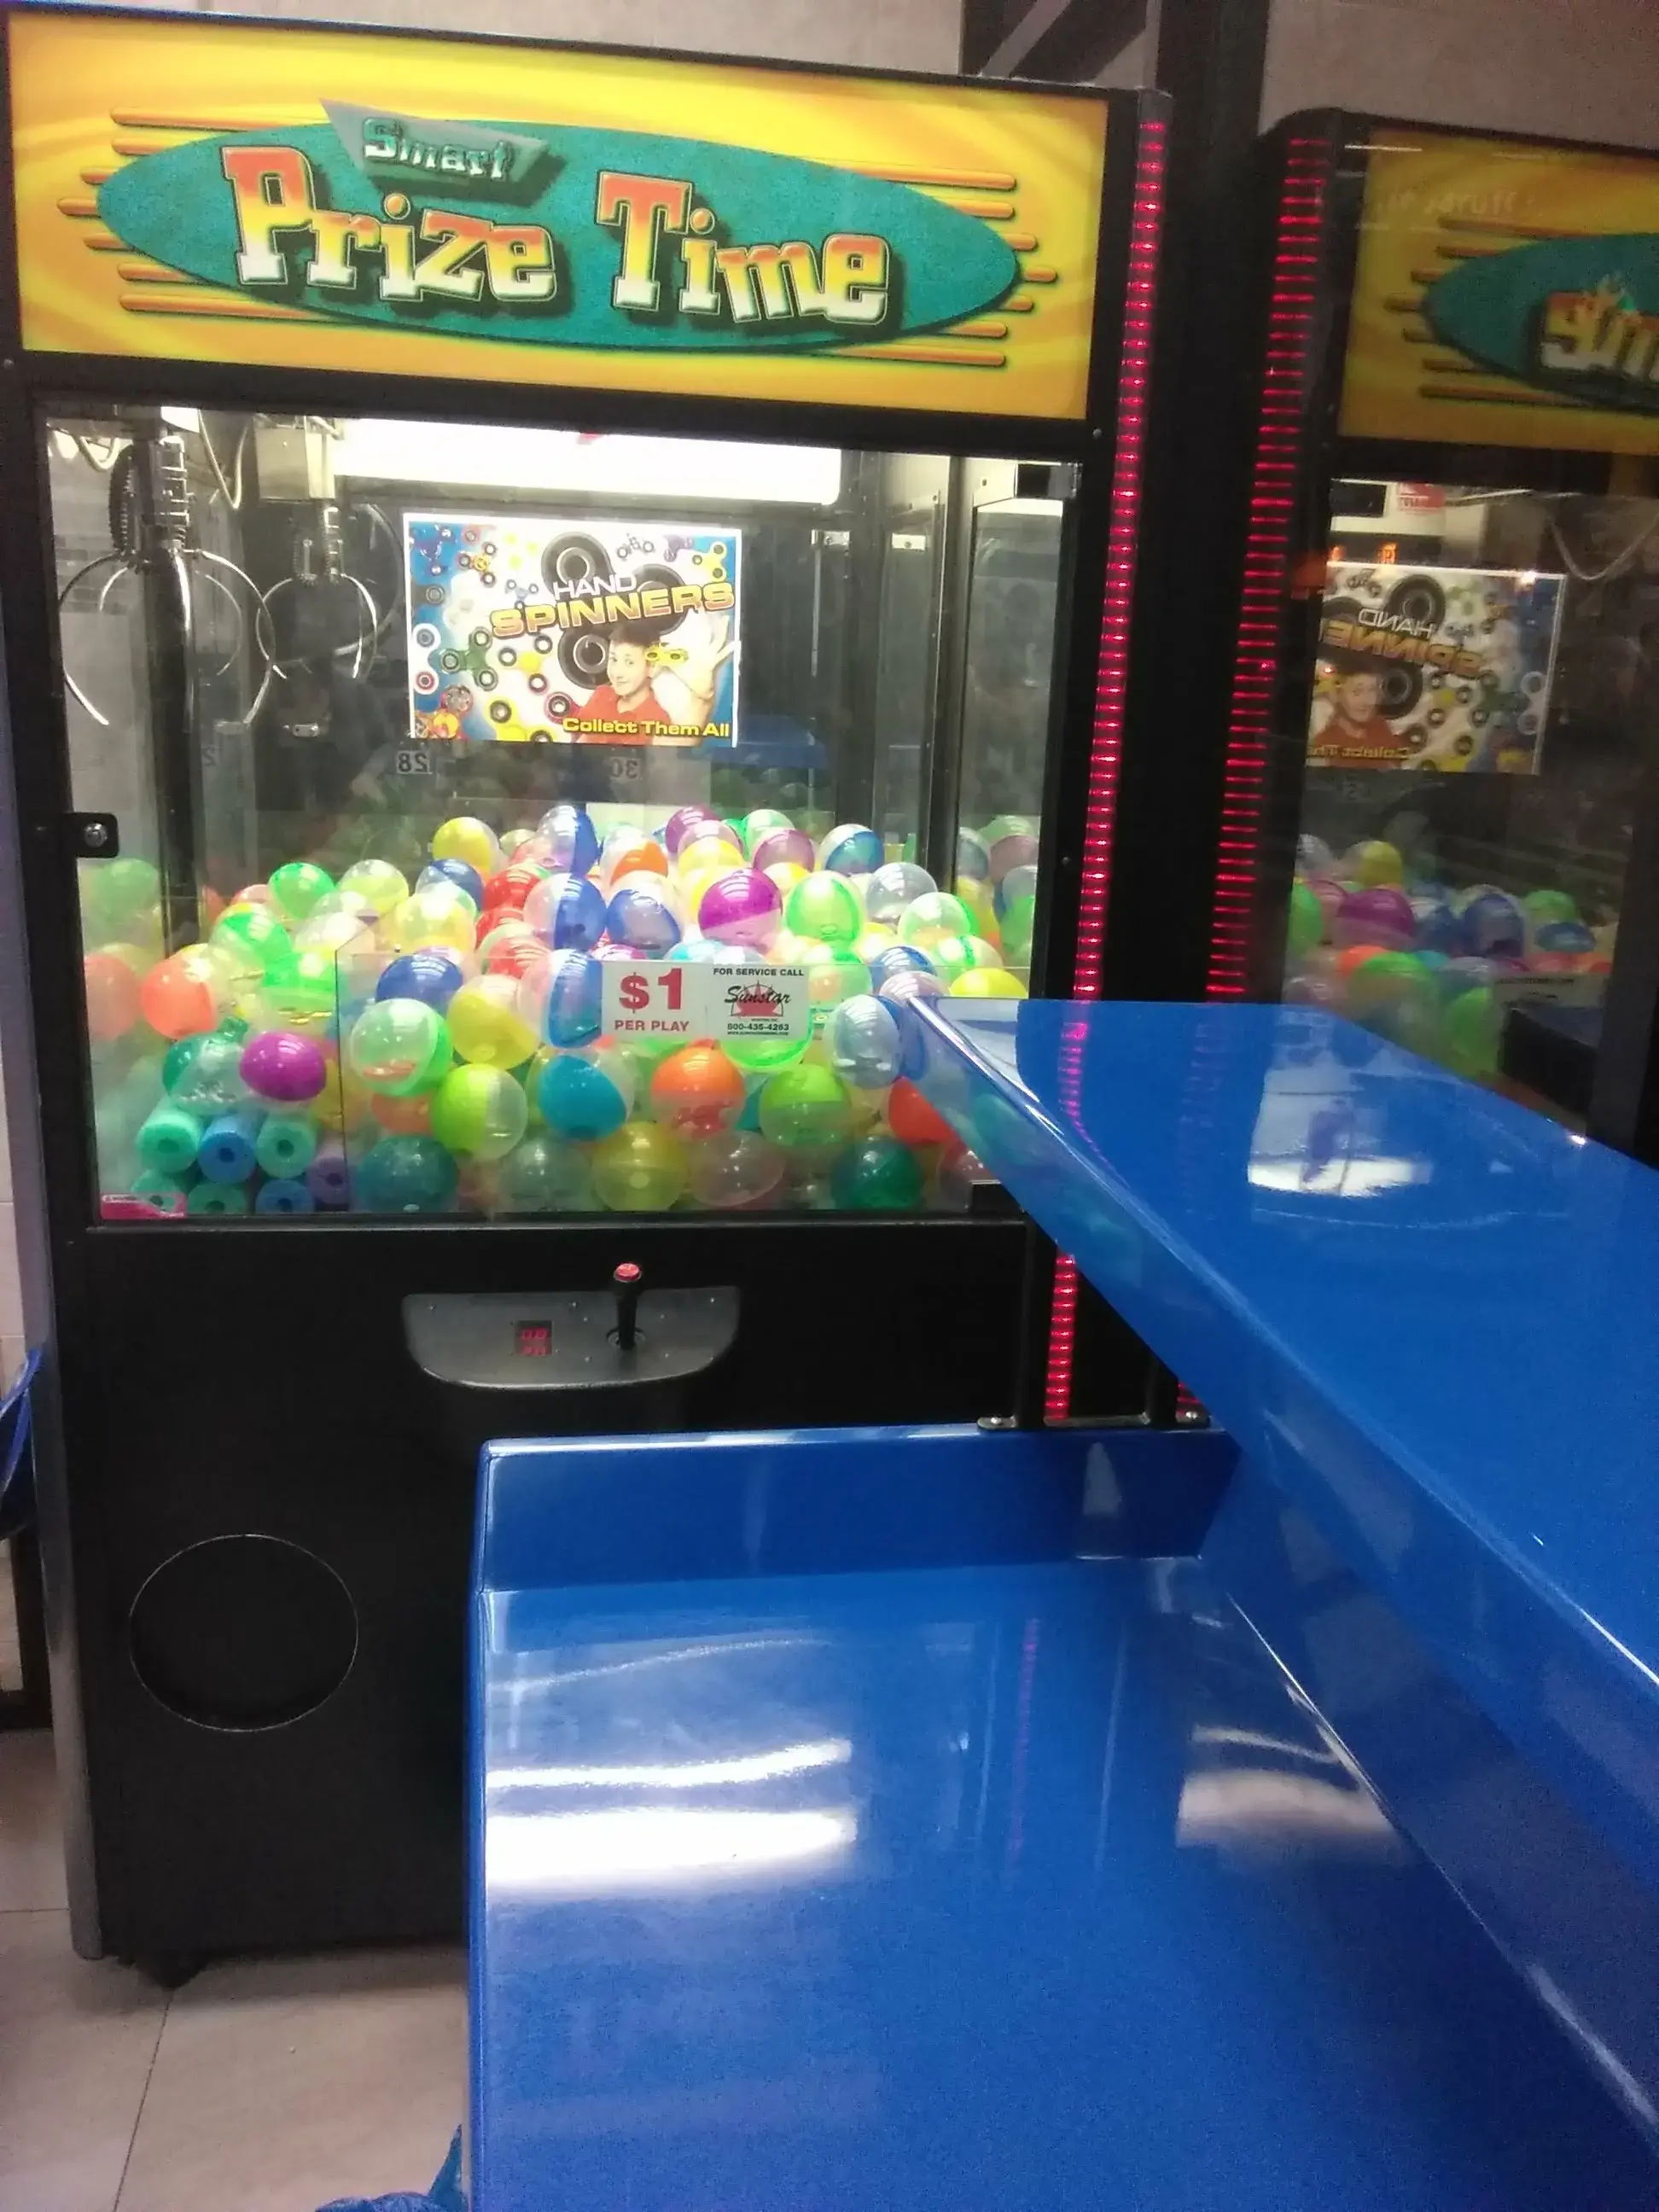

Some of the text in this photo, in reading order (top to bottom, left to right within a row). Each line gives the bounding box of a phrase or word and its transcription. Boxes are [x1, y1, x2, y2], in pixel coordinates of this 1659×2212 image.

[362, 116, 513, 179] Smart
[220, 146, 890, 325] Prize Time
[553, 573, 637, 601] HAND
[490, 581, 736, 638] SPINNERS
[562, 718, 731, 737] Collect Them All
[736, 968, 777, 976] SERVICE
[619, 967, 682, 1014] $1
[724, 985, 791, 1004] Sunstar
[614, 1020, 690, 1032] PER PLAY
